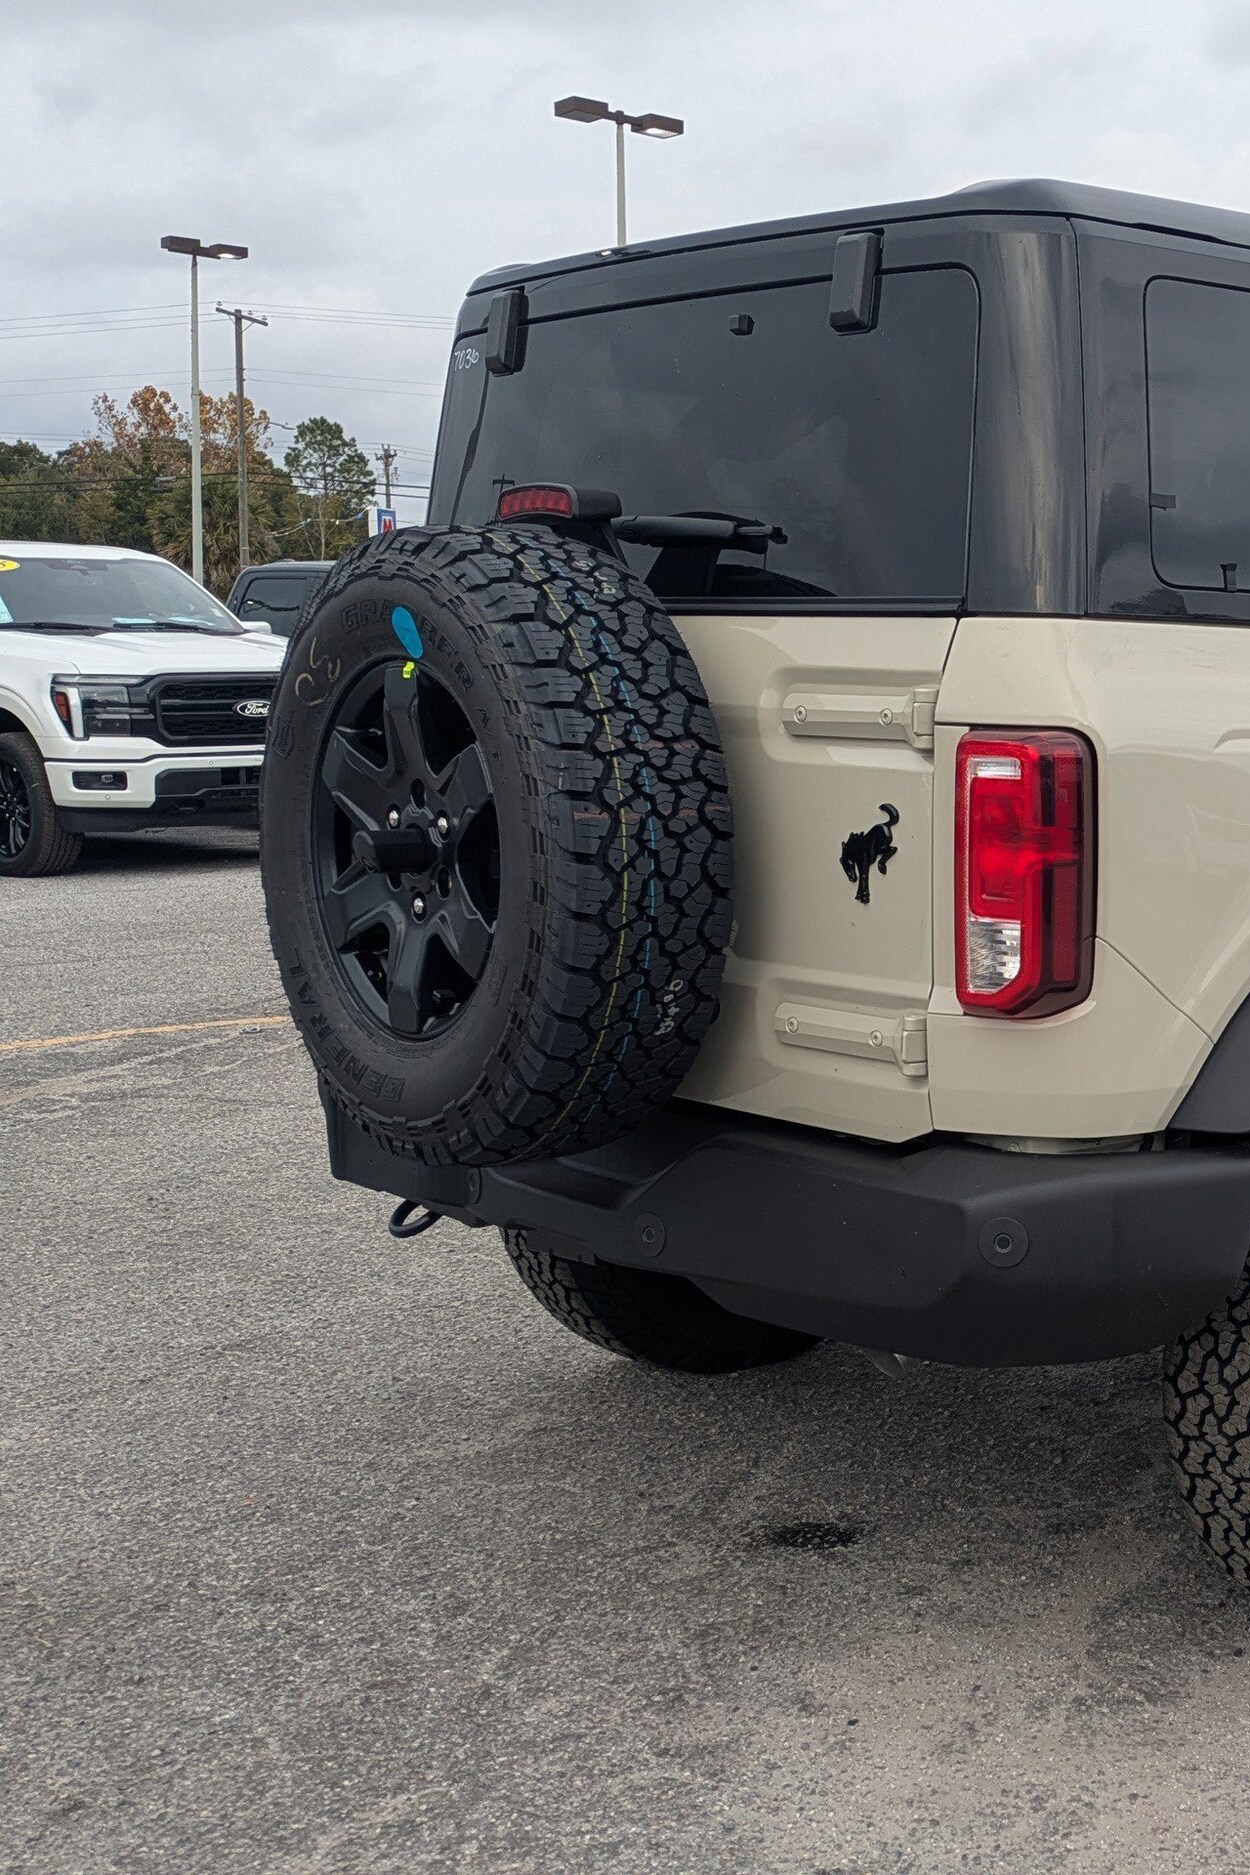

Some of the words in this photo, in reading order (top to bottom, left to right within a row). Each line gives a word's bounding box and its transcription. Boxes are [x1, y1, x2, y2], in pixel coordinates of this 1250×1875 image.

[454, 348, 480, 371] 7036
[340, 598, 475, 693] GRABER
[244, 702, 270, 714] Ford
[289, 947, 406, 1103] GENERAL
